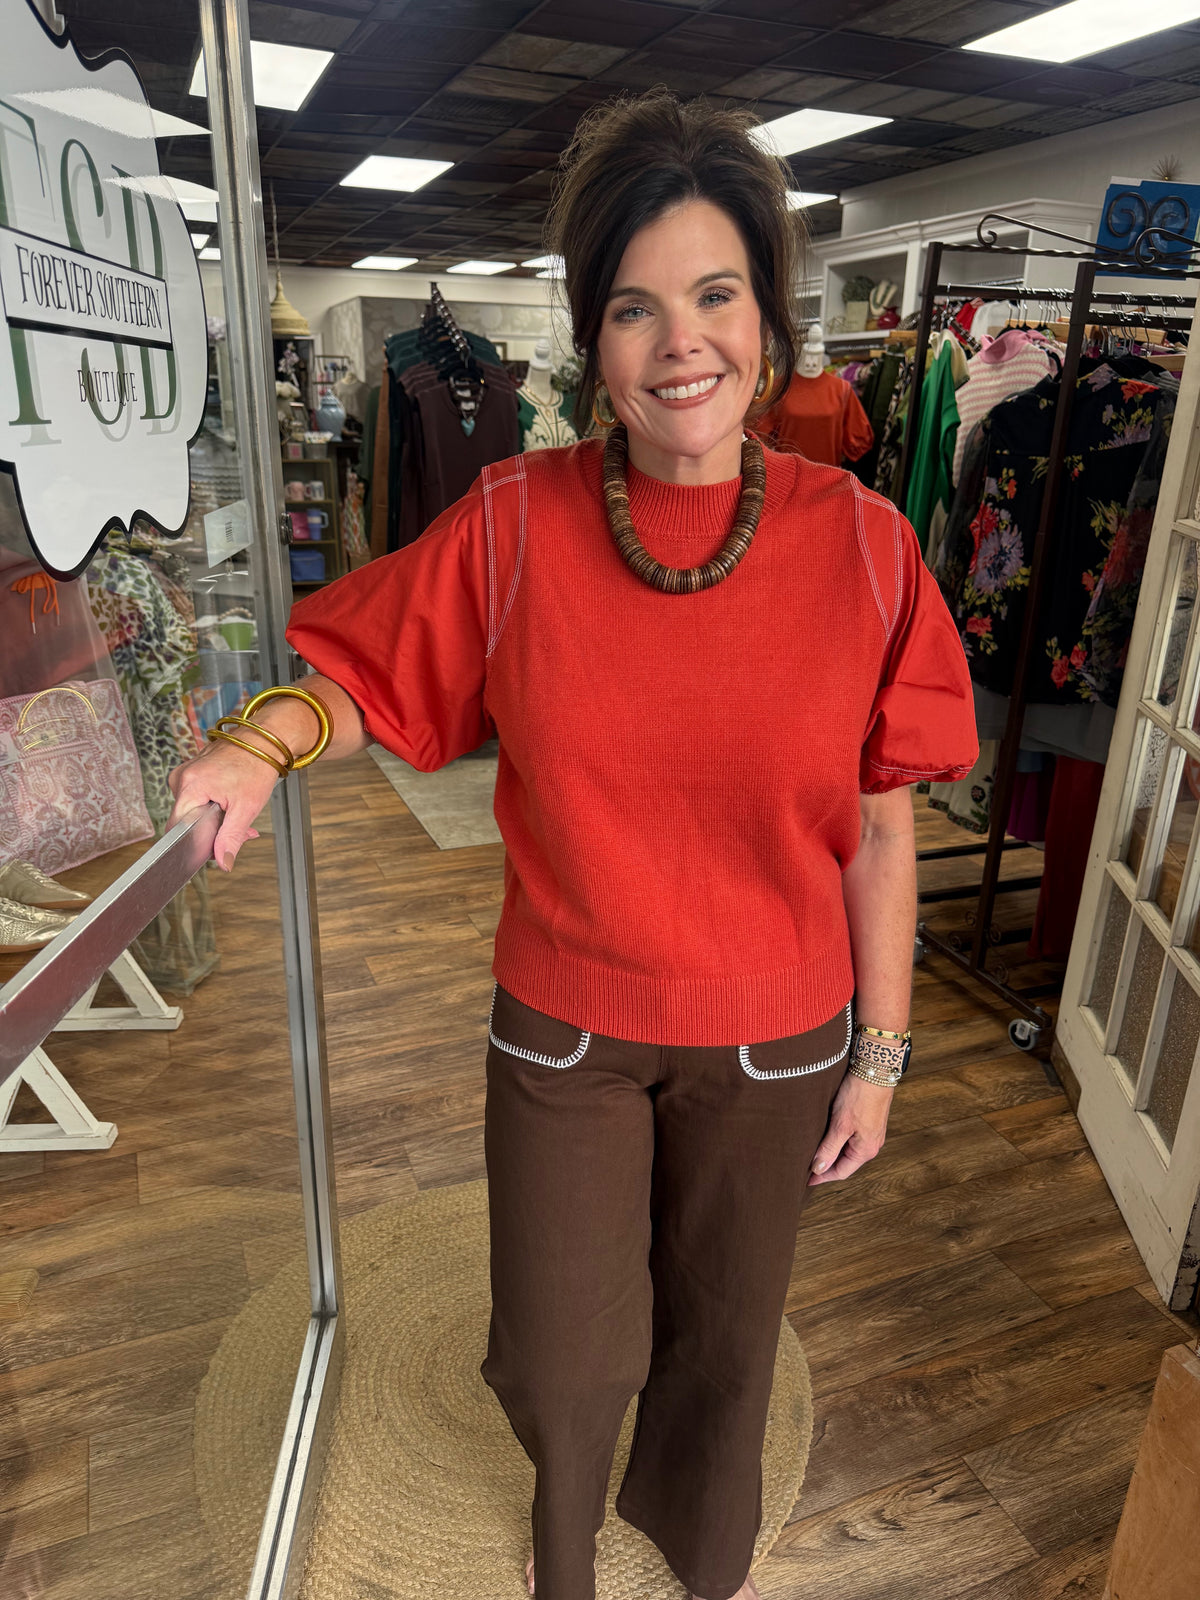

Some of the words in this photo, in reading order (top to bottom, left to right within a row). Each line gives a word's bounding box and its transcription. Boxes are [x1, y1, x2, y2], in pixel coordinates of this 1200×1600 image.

[15, 243, 97, 316] FOREVER
[96, 271, 163, 330] SOUTHERN
[77, 370, 138, 406] BOUTIQUE
